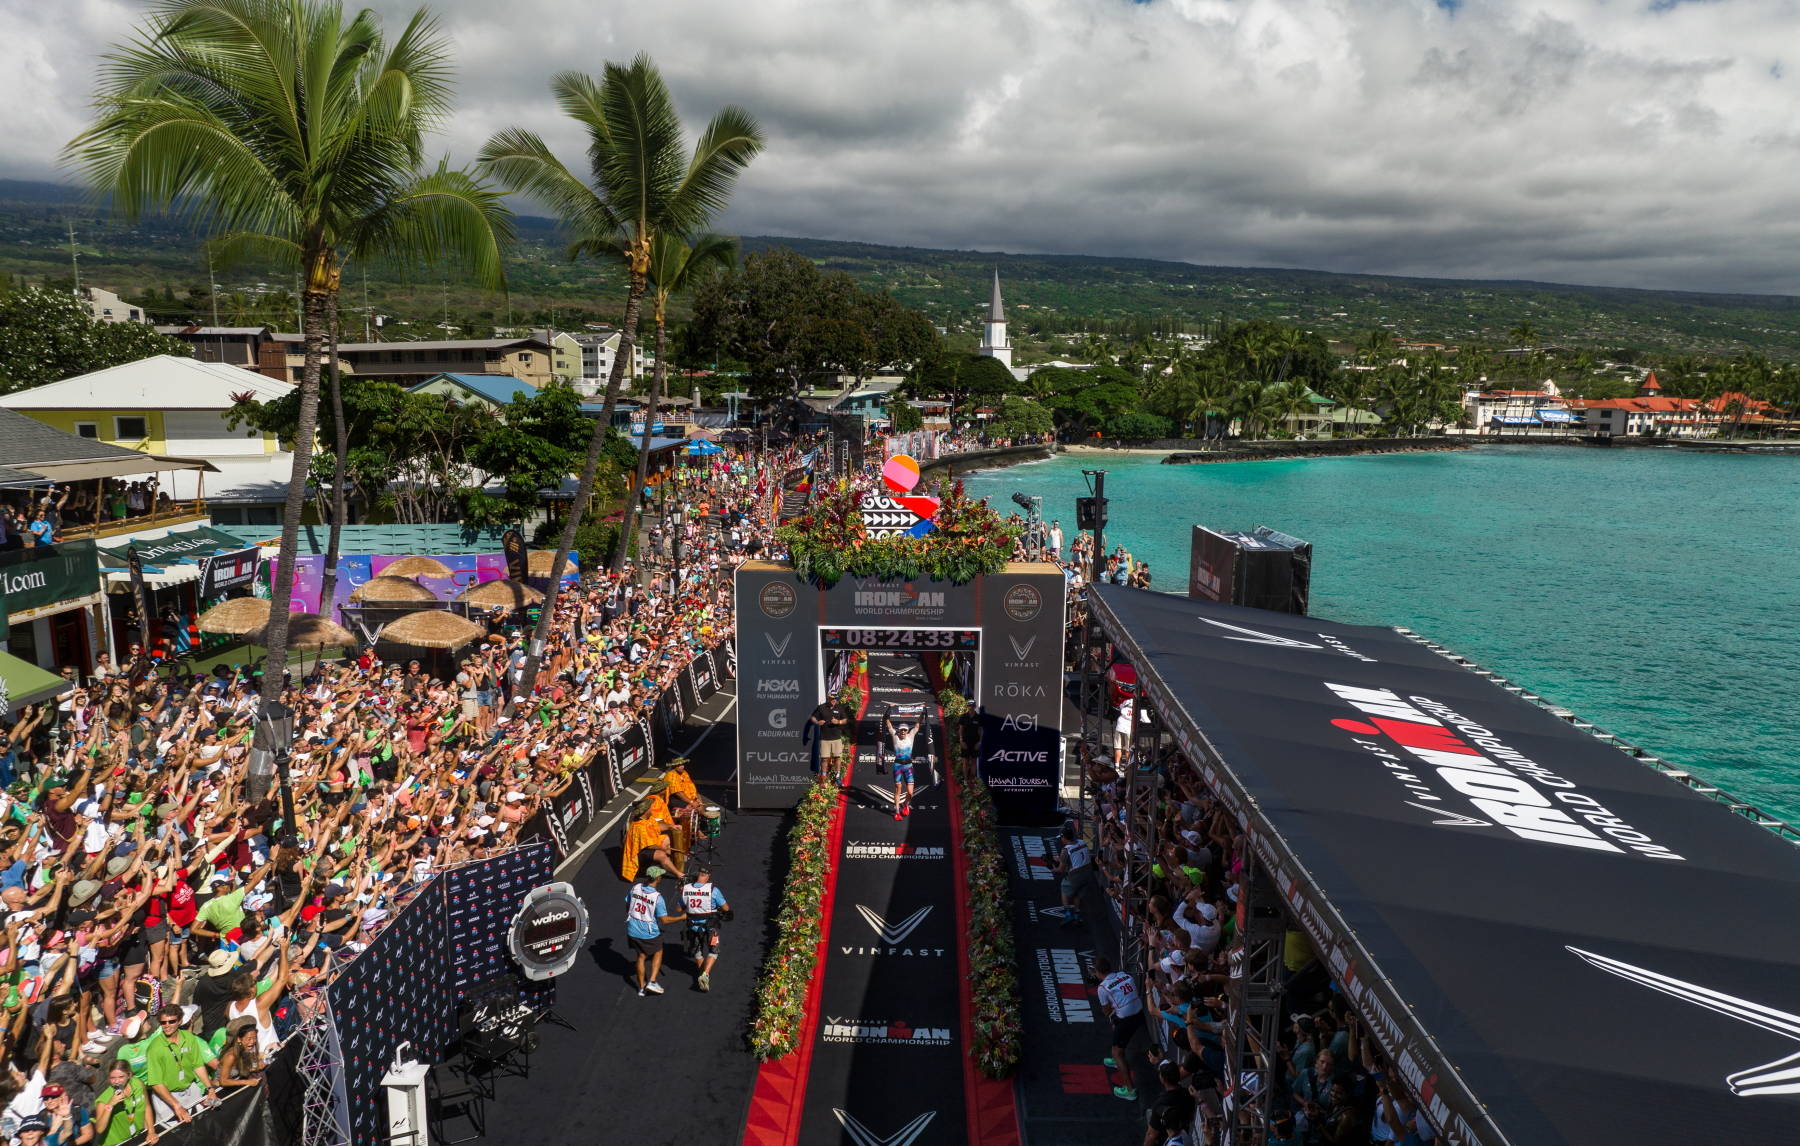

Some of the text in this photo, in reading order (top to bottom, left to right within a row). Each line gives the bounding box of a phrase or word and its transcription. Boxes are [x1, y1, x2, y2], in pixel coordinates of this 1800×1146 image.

[846, 630, 955, 646] 08:24:33
[757, 680, 800, 692] HOKA
[994, 682, 1046, 697] RŌKA
[1000, 713, 1038, 731] AG1
[757, 730, 800, 738] ENDURANCE
[746, 751, 809, 762] FULGAZ
[987, 749, 1049, 762] ACTIVE
[1324, 682, 1626, 854] IRONMAN
[1352, 737, 1442, 801] VINFAST
[1019, 777, 1049, 786] TOURISM
[1409, 695, 1687, 861] WORLD CHAMPIONSHIP
[846, 845, 944, 855] IRONMAN
[635, 903, 647, 915] 39
[690, 898, 703, 909] 32
[532, 911, 570, 926] wahoo
[842, 946, 944, 956] VINFAST
[1120, 983, 1134, 995] 26
[823, 1023, 950, 1039] IRONMAN
[866, 1037, 950, 1045] CHAMPIONSHIP
